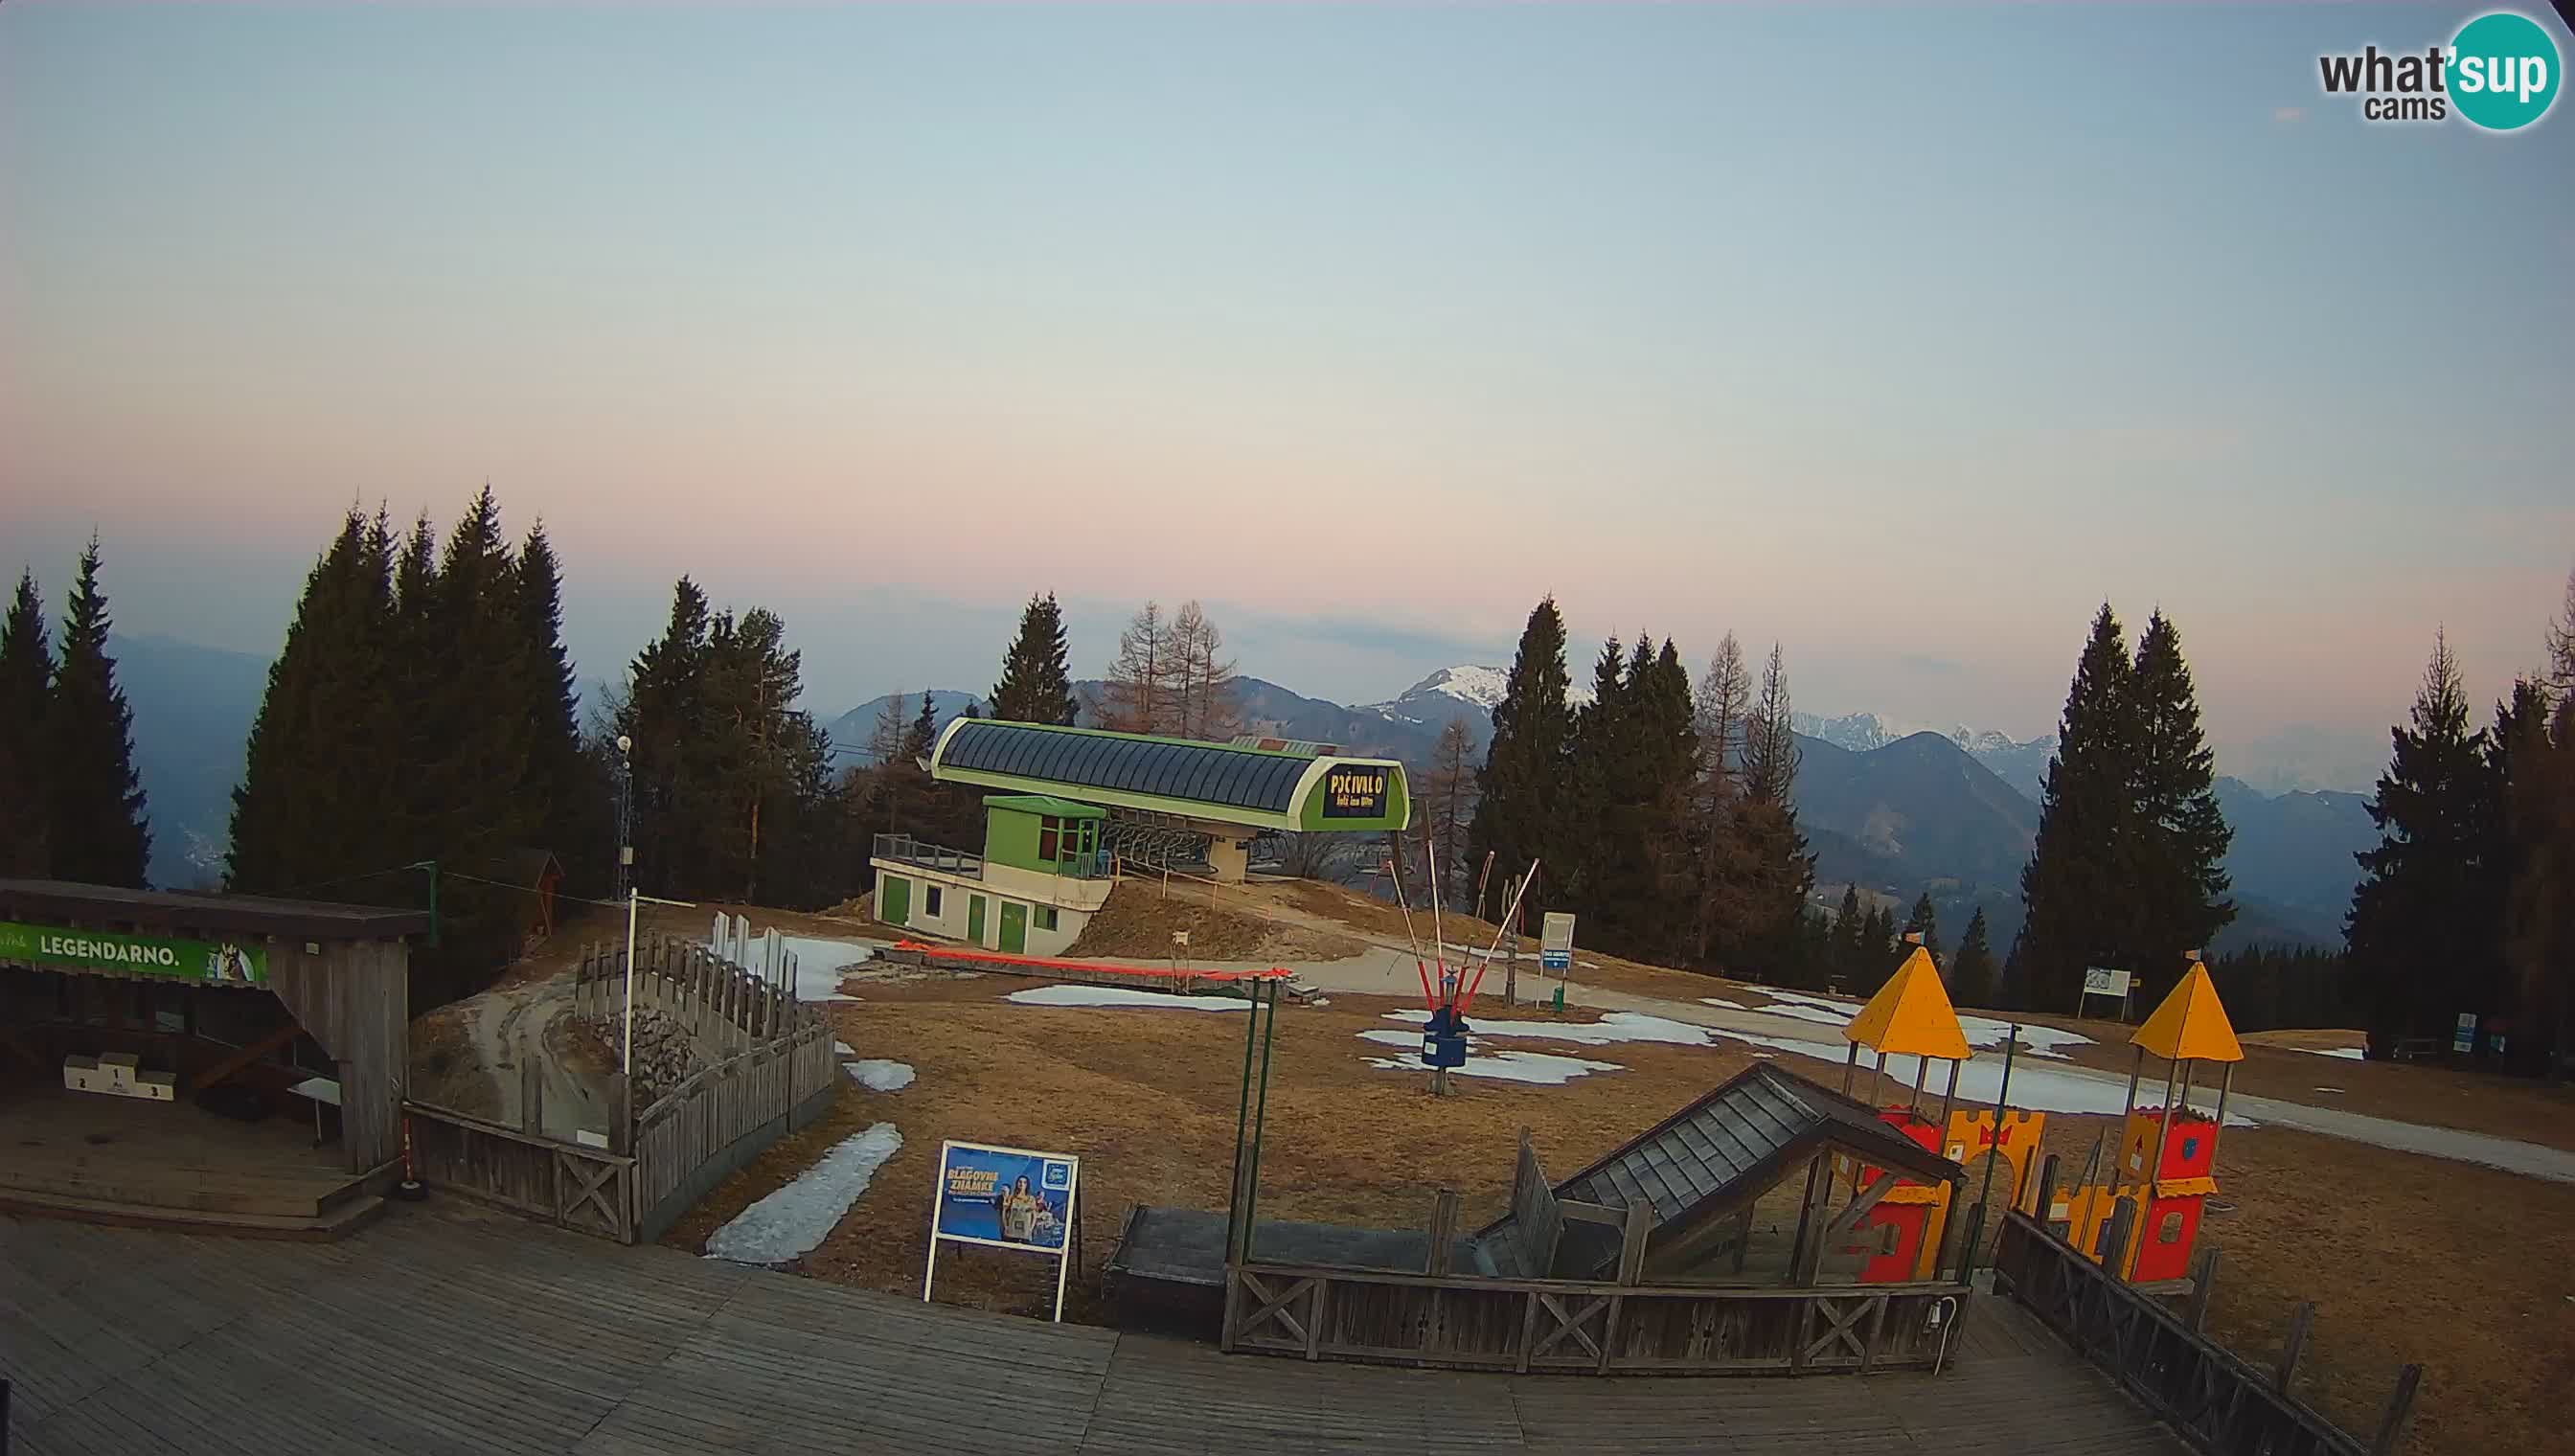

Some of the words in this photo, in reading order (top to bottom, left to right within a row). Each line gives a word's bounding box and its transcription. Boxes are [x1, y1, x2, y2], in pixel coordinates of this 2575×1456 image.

[39, 935, 180, 967] LEGENDARNO.
[113, 1068, 119, 1079] 1
[80, 1078, 86, 1088] 2
[151, 1086, 158, 1097] 3
